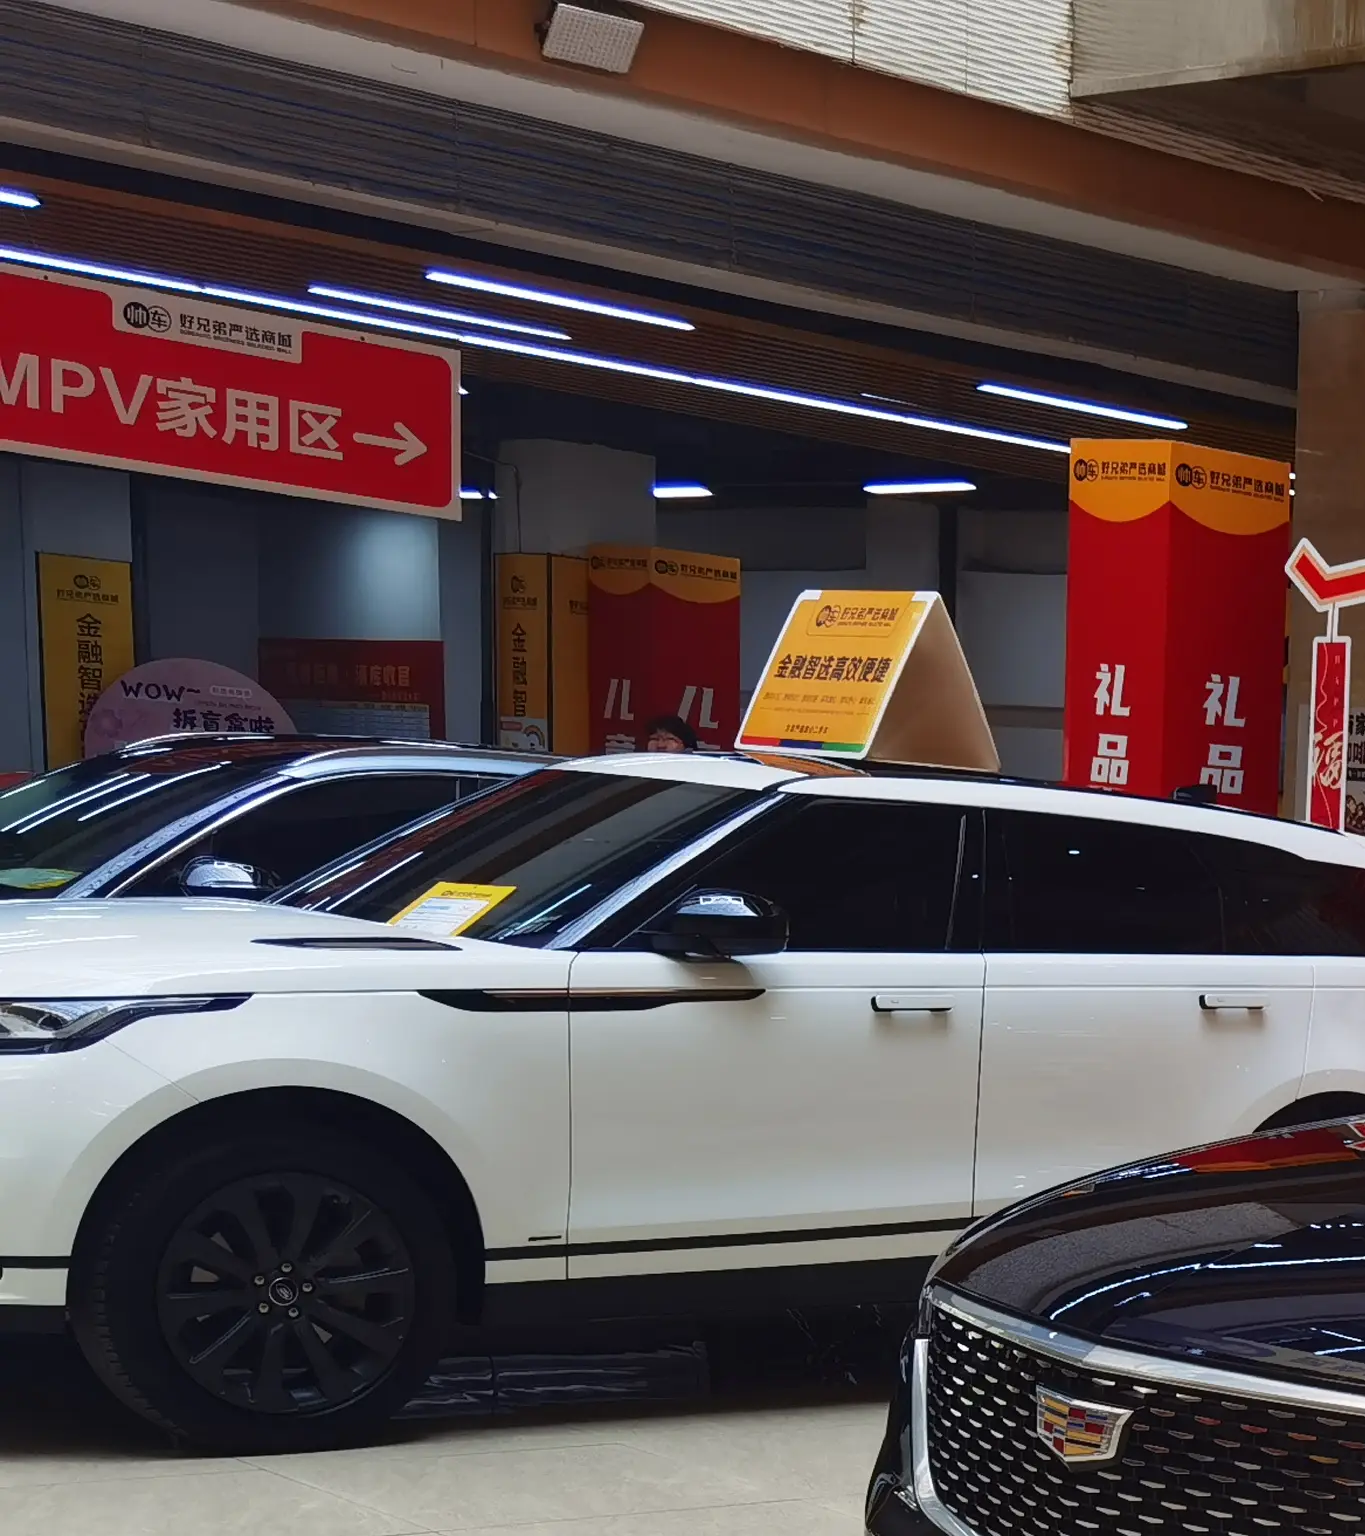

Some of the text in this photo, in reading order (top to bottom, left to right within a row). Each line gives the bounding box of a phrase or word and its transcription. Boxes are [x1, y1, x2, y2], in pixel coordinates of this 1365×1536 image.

[179, 313, 293, 348] 好兄弟严选商城
[0, 354, 344, 461] MPV家用区
[1090, 663, 1132, 786] 礼品
[1199, 673, 1247, 795] 礼品
